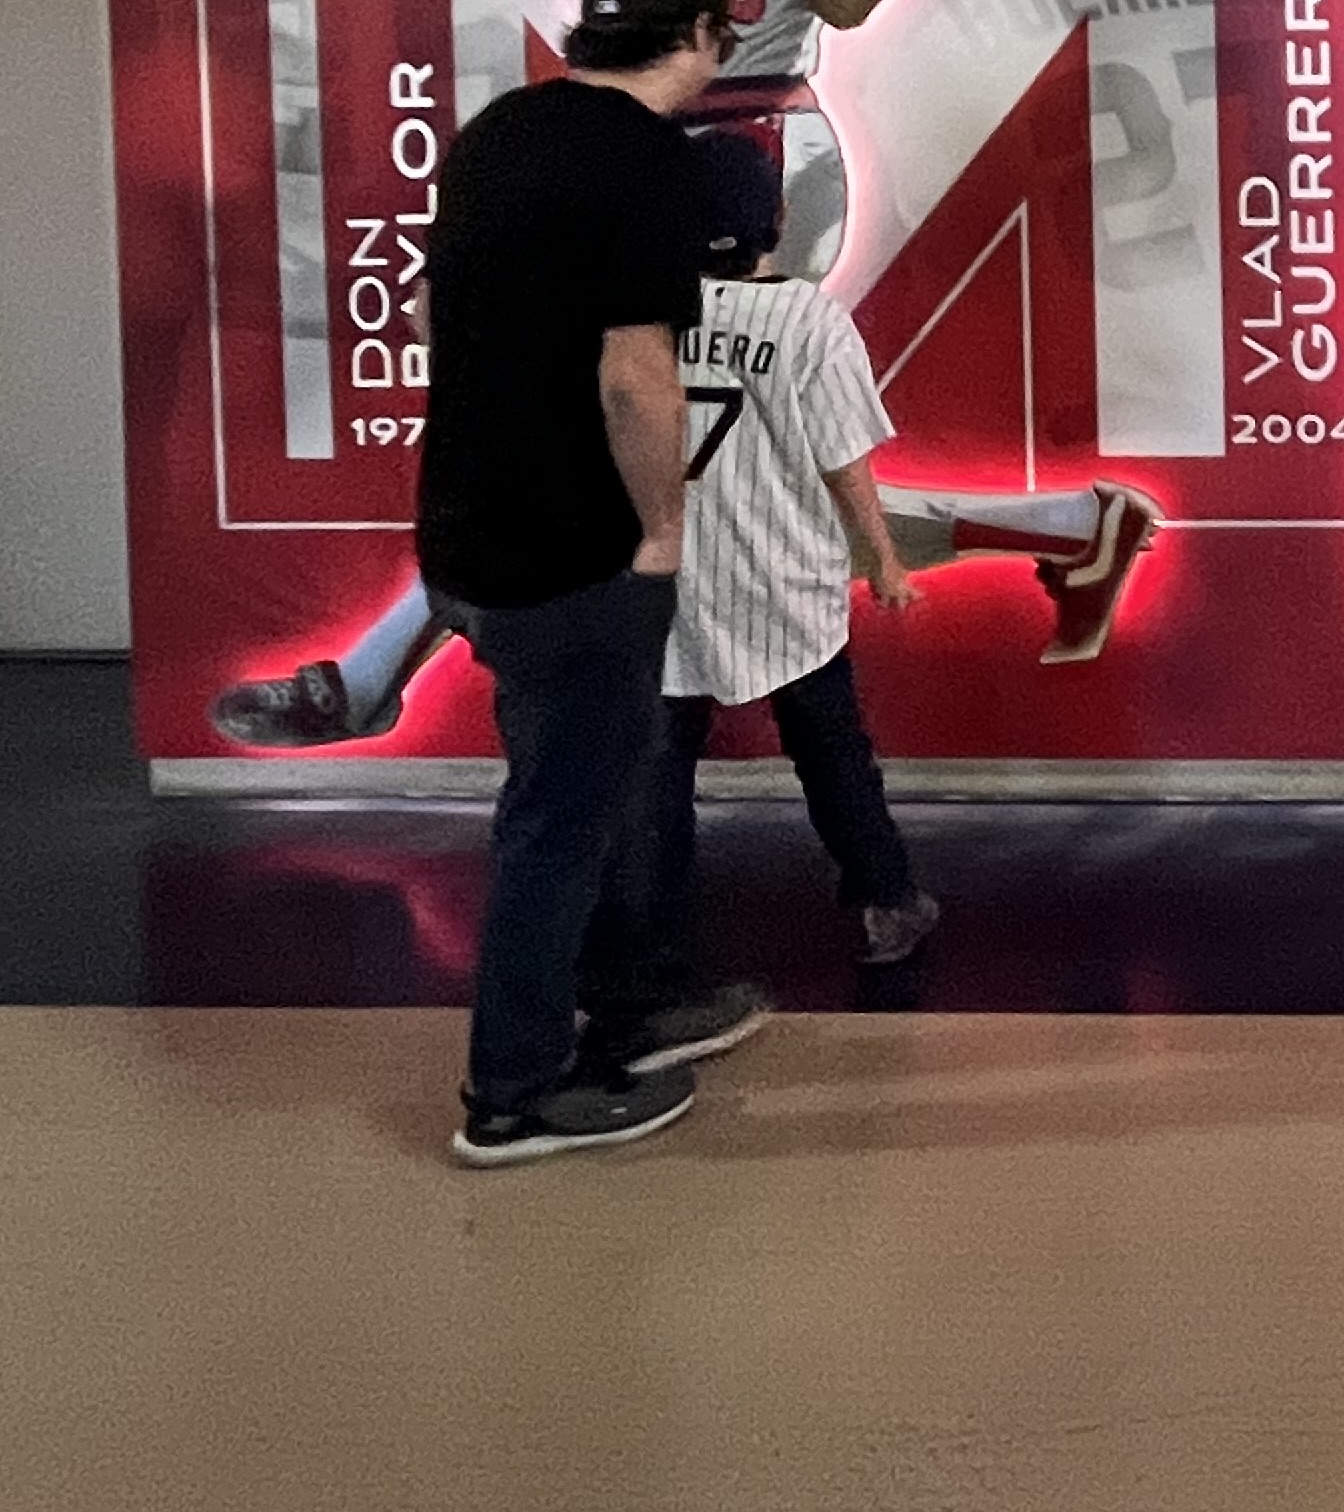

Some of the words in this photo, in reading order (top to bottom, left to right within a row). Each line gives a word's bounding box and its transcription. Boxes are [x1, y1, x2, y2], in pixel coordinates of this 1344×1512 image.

[389, 61, 437, 388] BYLOR
[1239, 175, 1283, 385] VLAD
[346, 218, 394, 388] DON
[681, 326, 776, 375] UERO
[350, 416, 426, 446] 197
[684, 387, 744, 482] 7
